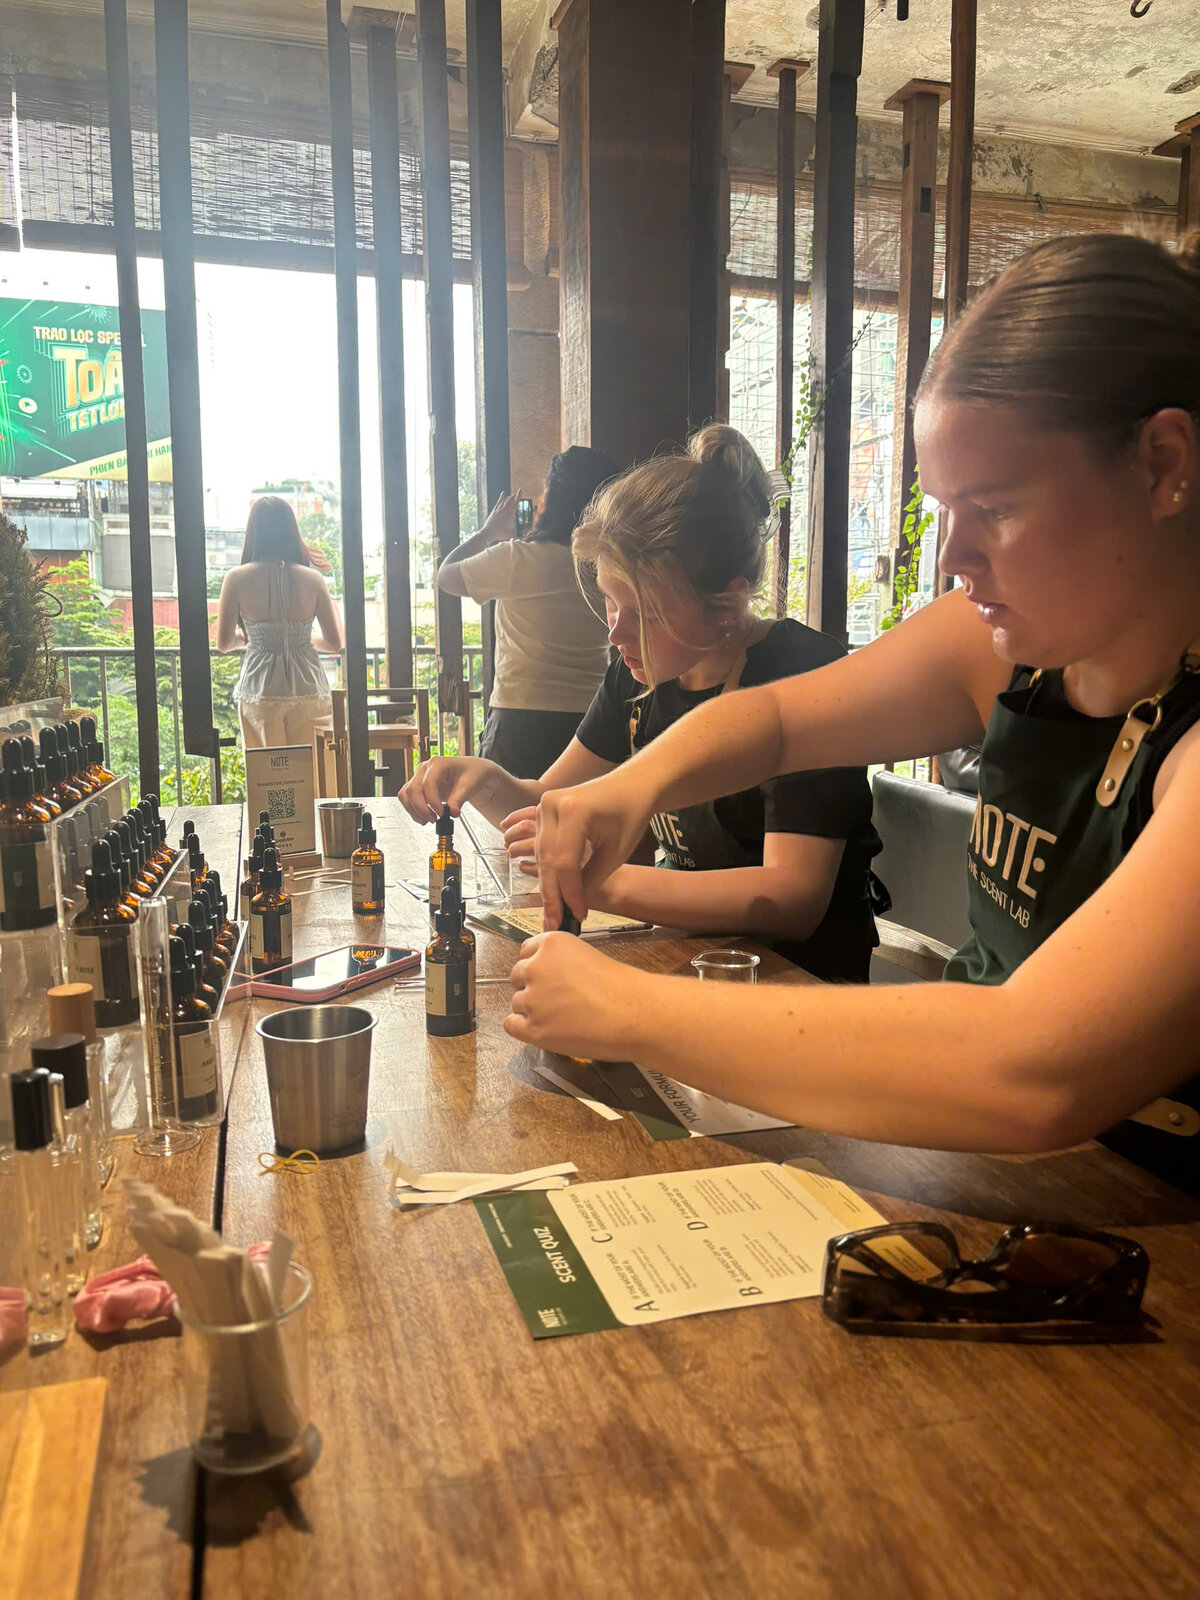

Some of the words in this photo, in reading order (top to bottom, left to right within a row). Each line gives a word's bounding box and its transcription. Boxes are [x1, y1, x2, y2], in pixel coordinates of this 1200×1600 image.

[271, 756, 289, 767] NOTE
[980, 871, 1009, 910] SCENT
[1010, 900, 1030, 929] LAB
[670, 1101, 702, 1123] YOUR
[686, 1221, 709, 1231] D
[533, 1226, 559, 1250] QUIZ
[591, 1233, 613, 1243] C
[545, 1251, 576, 1283] SCENT
[739, 1286, 763, 1297] B
[634, 1301, 660, 1312] A
[537, 1308, 561, 1329] NOTE
